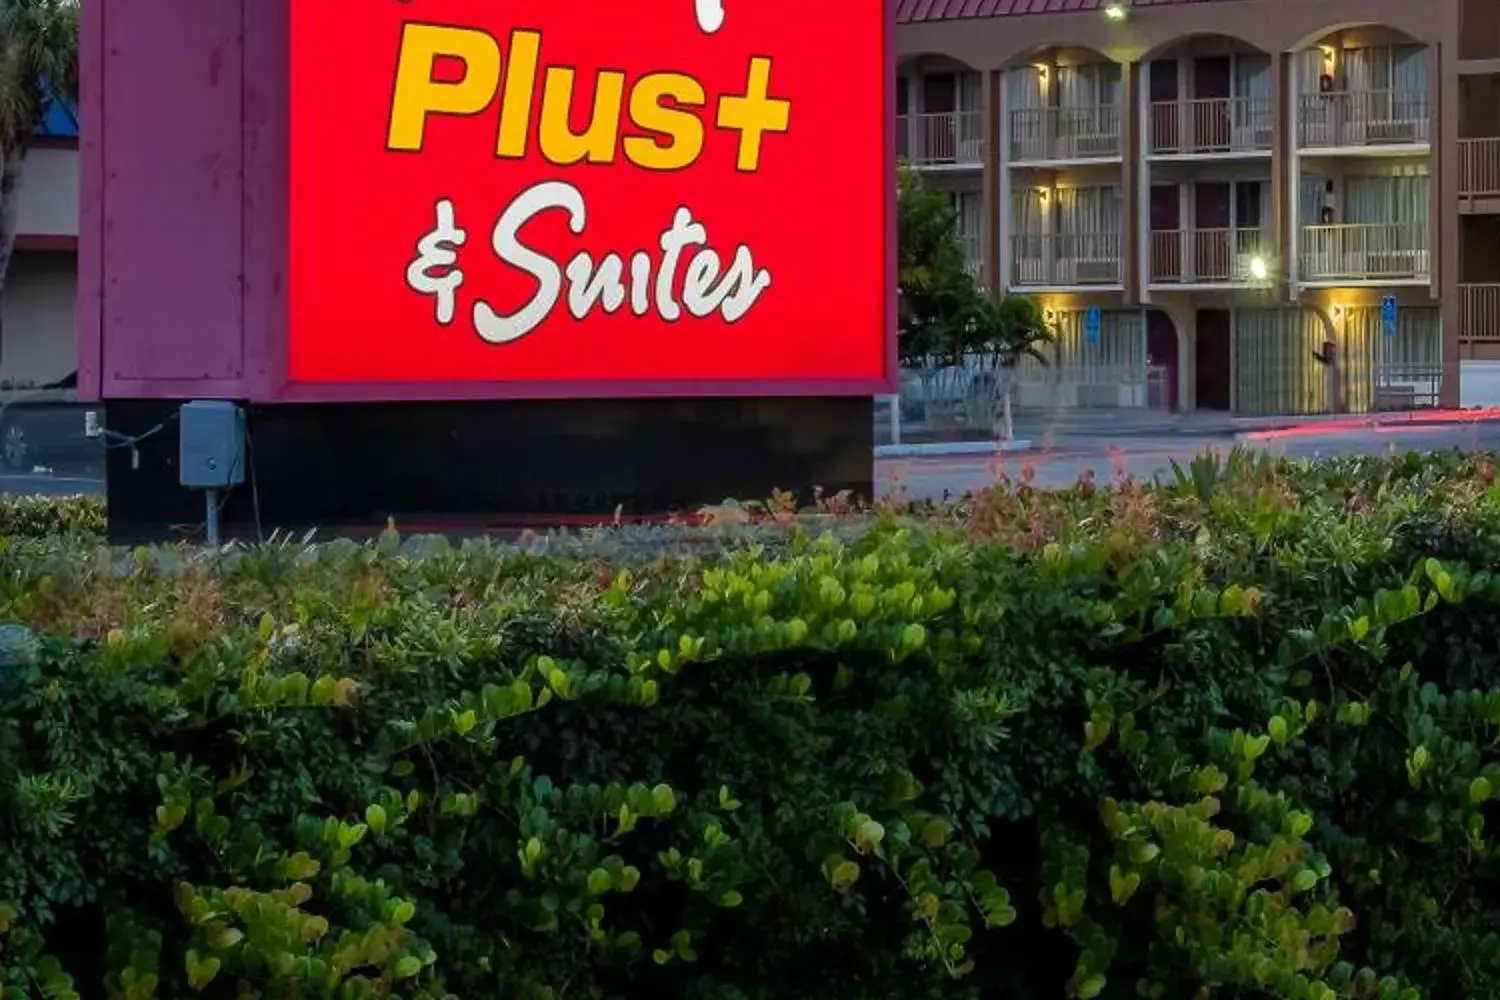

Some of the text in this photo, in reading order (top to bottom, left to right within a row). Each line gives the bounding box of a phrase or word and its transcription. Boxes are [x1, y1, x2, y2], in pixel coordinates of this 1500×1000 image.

[388, 22, 791, 172] Plus+
[407, 181, 771, 344] & Suites
